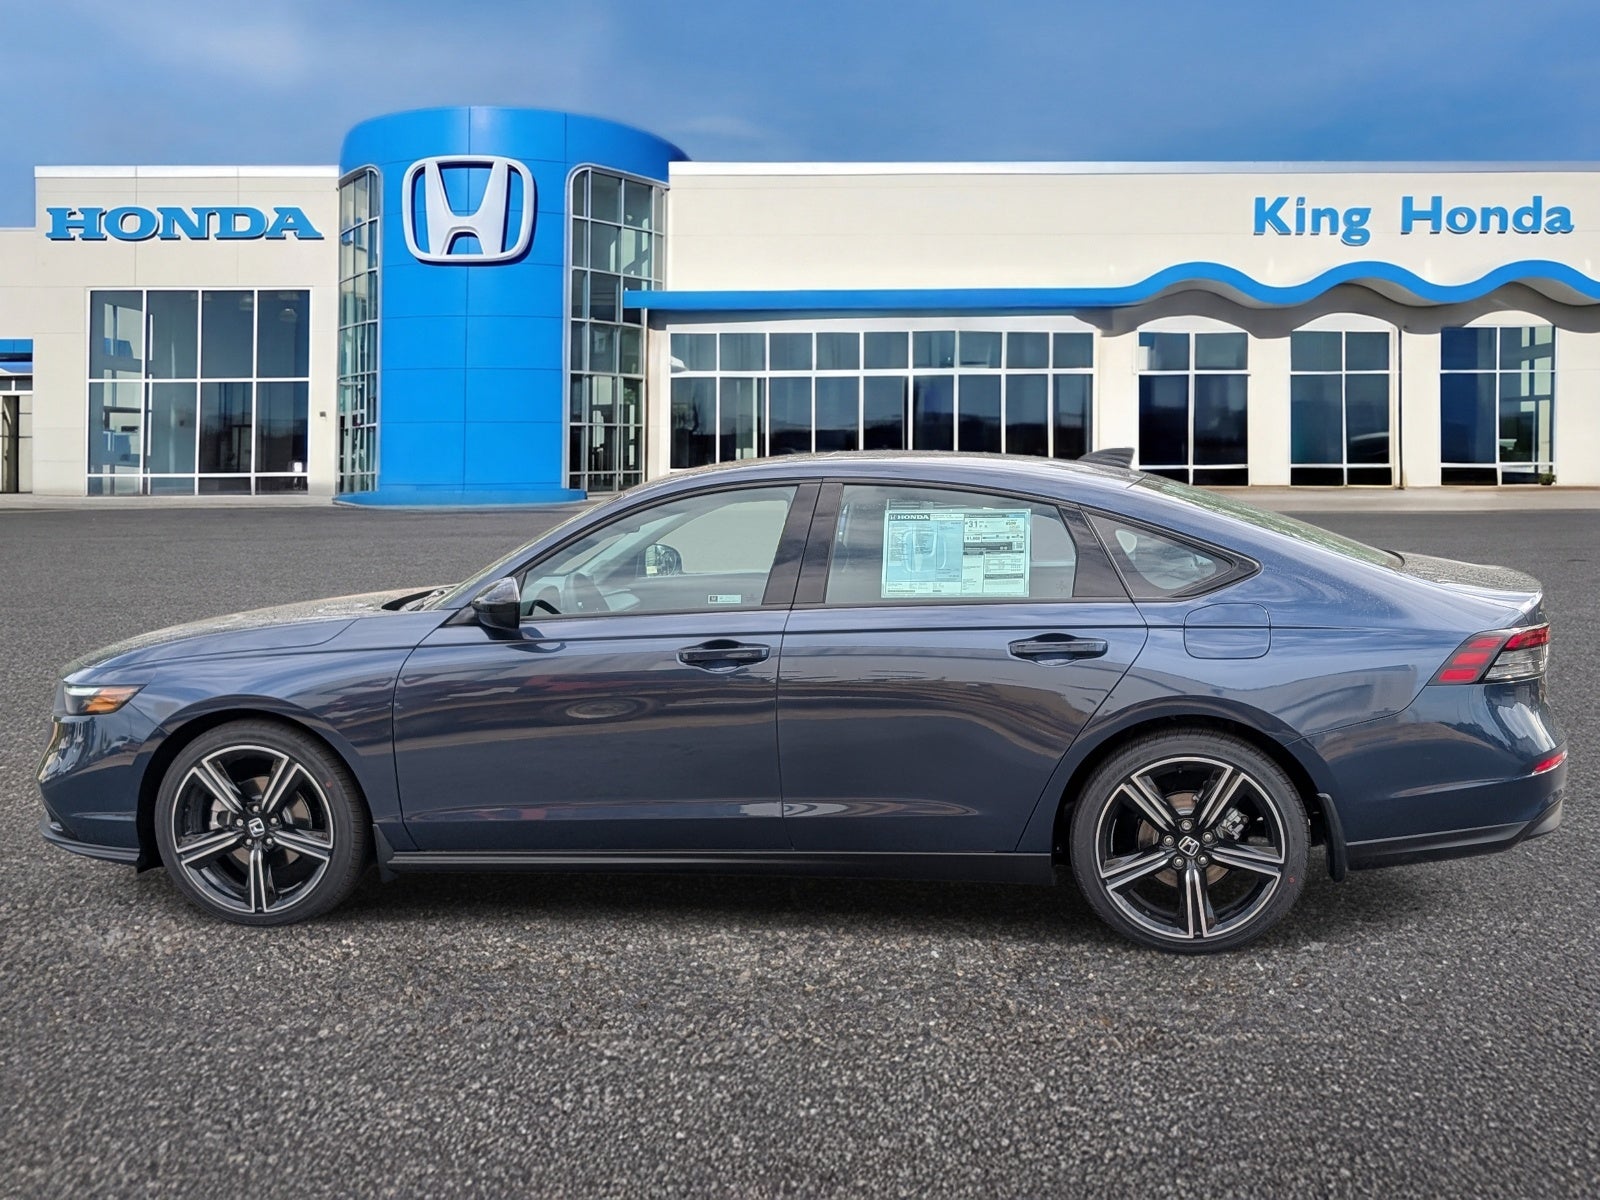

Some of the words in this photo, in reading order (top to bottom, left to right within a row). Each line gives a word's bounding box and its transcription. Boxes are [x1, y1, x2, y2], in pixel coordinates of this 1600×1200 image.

[45, 206, 323, 240] HONDA
[1253, 196, 1371, 245] King
[1400, 195, 1574, 235] Honda
